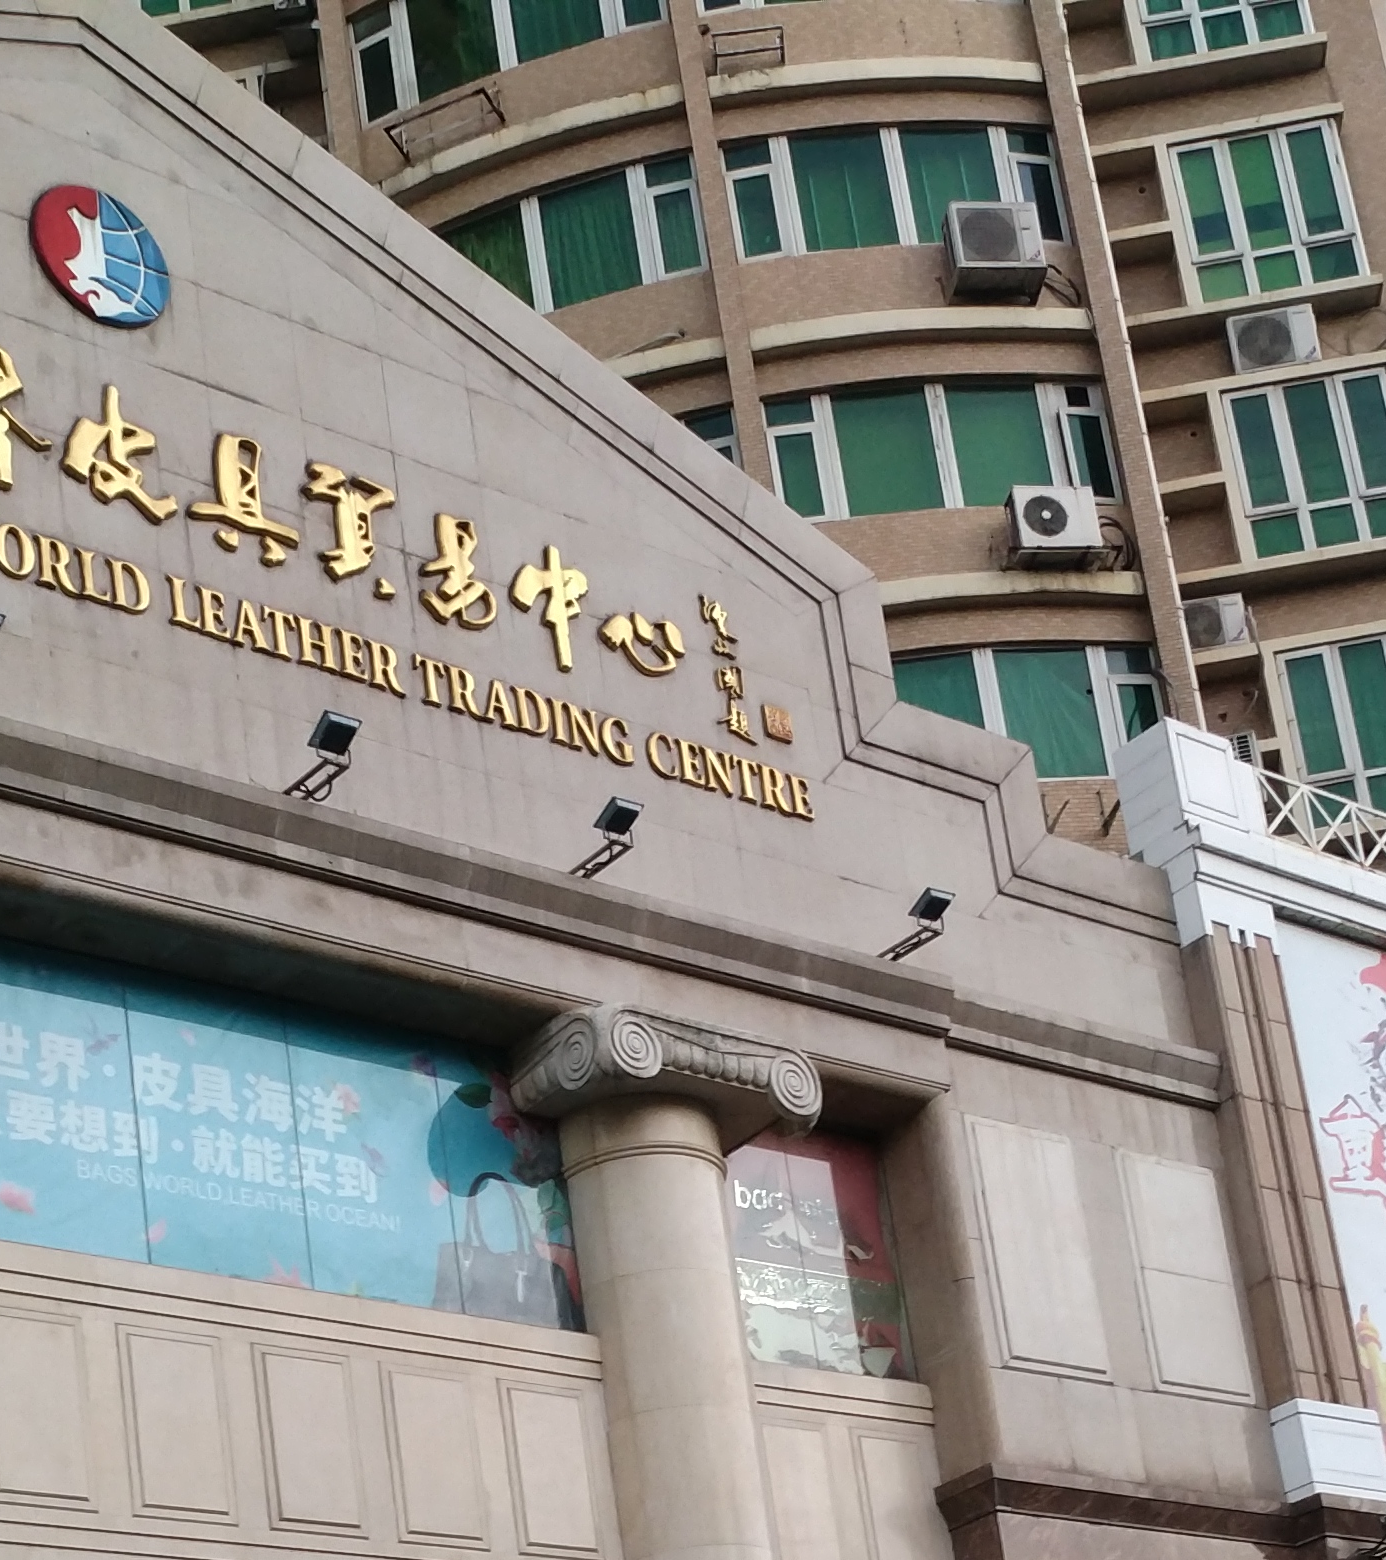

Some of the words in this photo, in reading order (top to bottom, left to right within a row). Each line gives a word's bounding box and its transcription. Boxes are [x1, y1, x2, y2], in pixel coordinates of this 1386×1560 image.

[167, 573, 407, 700] LEATHER
[413, 653, 637, 768] TRADING
[645, 731, 816, 821] CENTRE
[76, 1158, 138, 1187] BAGS
[143, 1169, 222, 1202] WORLD
[228, 1185, 320, 1221] LEATHER
[325, 1203, 402, 1233] OCEAN!
